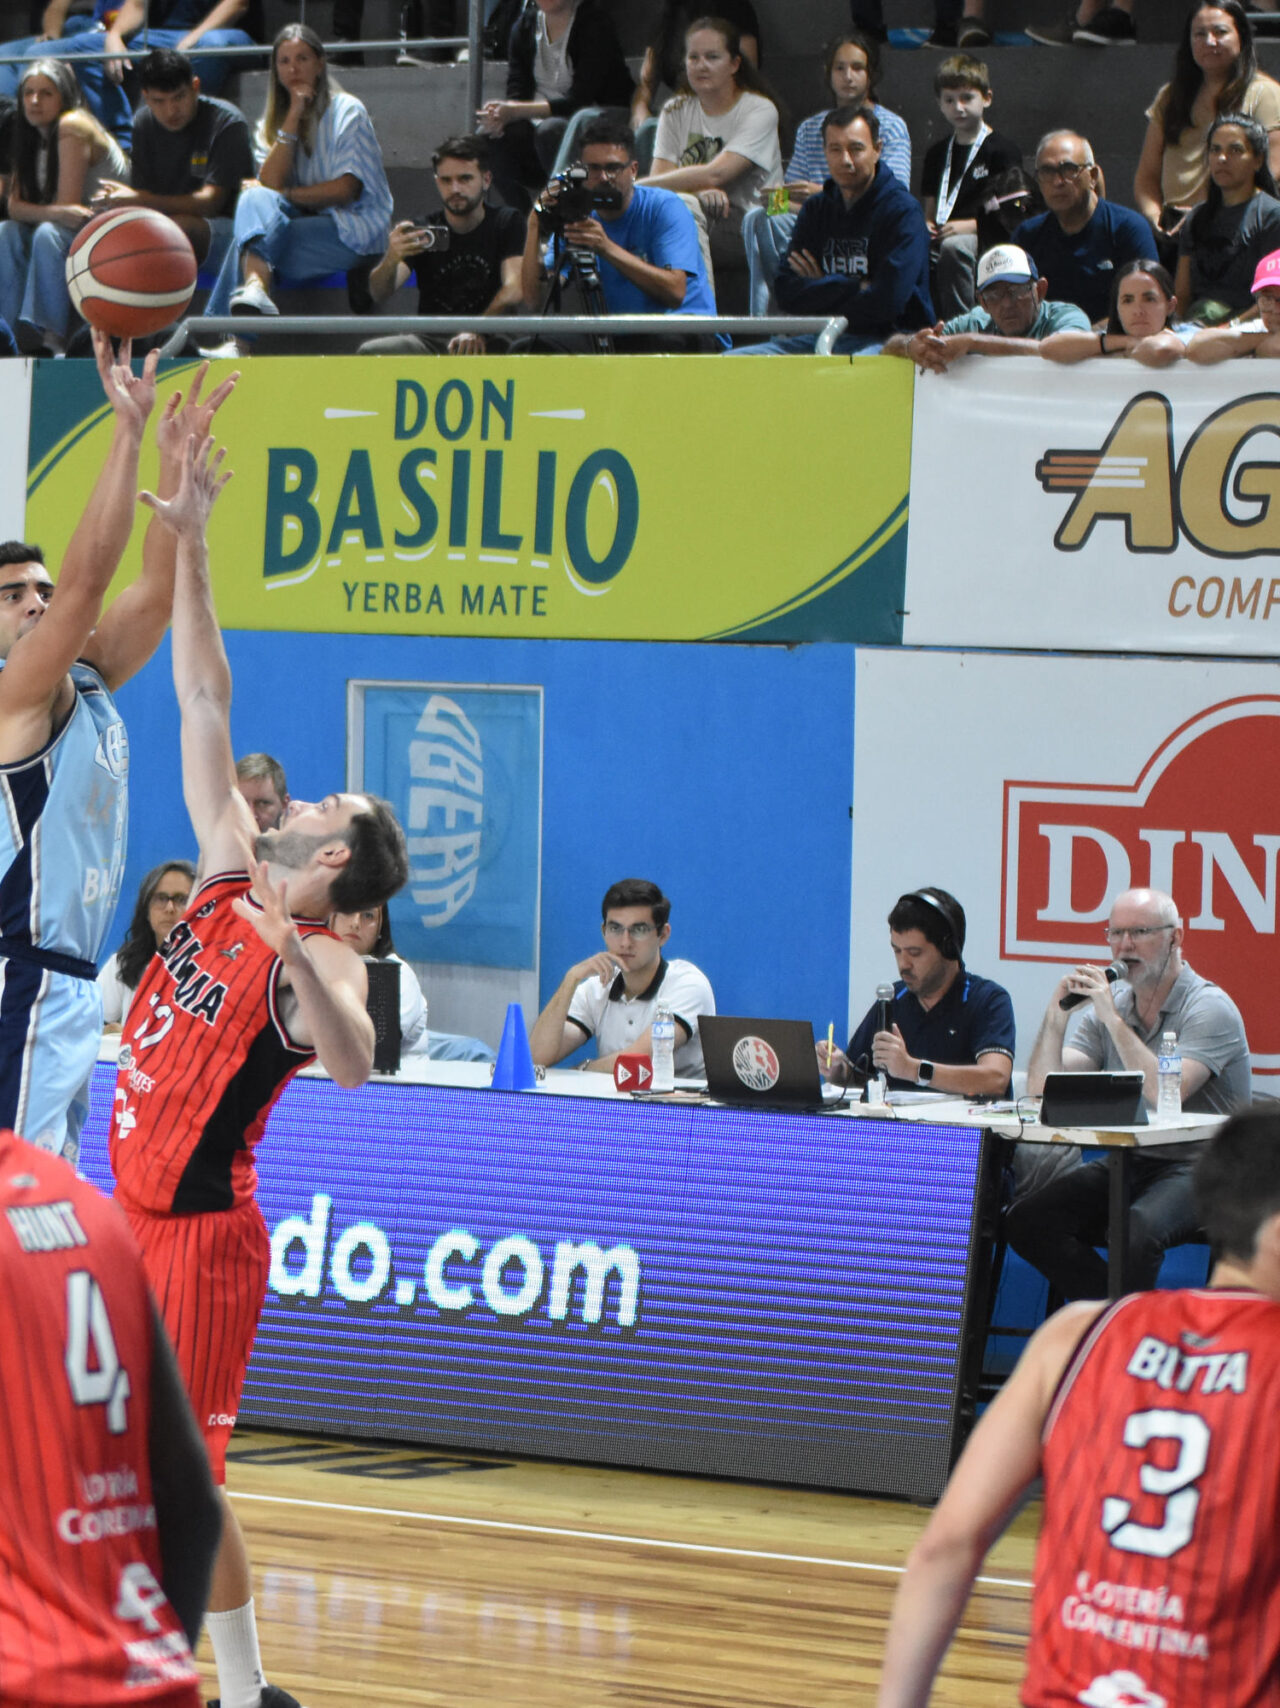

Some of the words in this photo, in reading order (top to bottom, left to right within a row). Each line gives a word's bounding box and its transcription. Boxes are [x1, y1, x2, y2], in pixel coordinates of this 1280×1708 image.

[394, 379, 514, 441] DON
[1036, 391, 1280, 559] AG
[263, 447, 639, 584] BASILIO
[343, 582, 444, 614] YERBA
[461, 584, 548, 616] MATE
[1037, 823, 1280, 934] DIN
[65, 1270, 131, 1434] 4
[1102, 1408, 1210, 1558] 3
